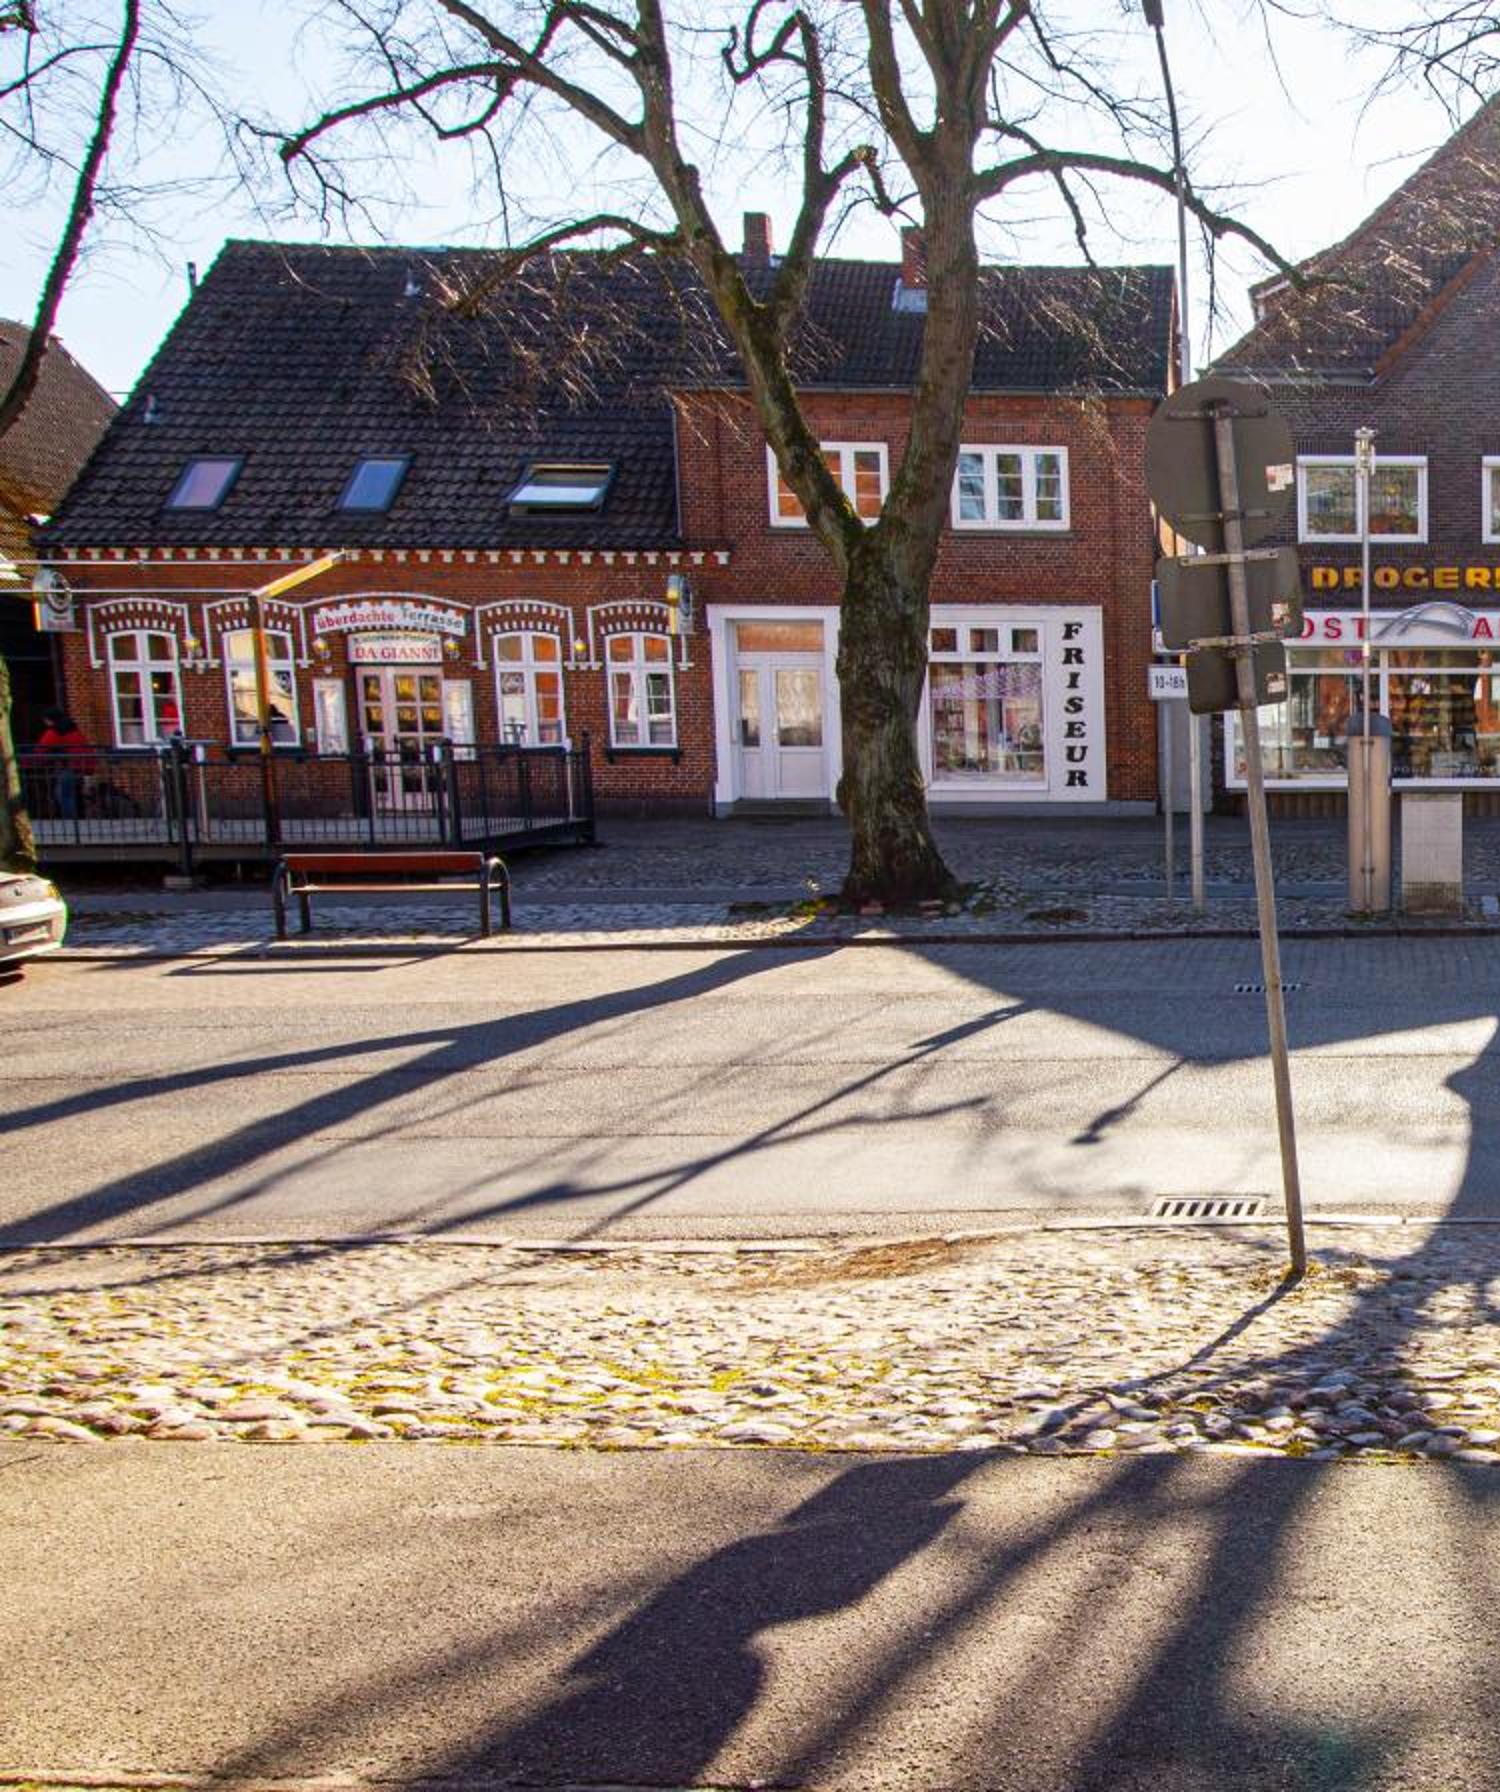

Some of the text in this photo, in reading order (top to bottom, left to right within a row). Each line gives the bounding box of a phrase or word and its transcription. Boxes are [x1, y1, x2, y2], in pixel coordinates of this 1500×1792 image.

[1301, 617, 1367, 640] OST
[354, 647, 439, 660] DA GIANNI
[1062, 622, 1088, 787] FRISEUR
